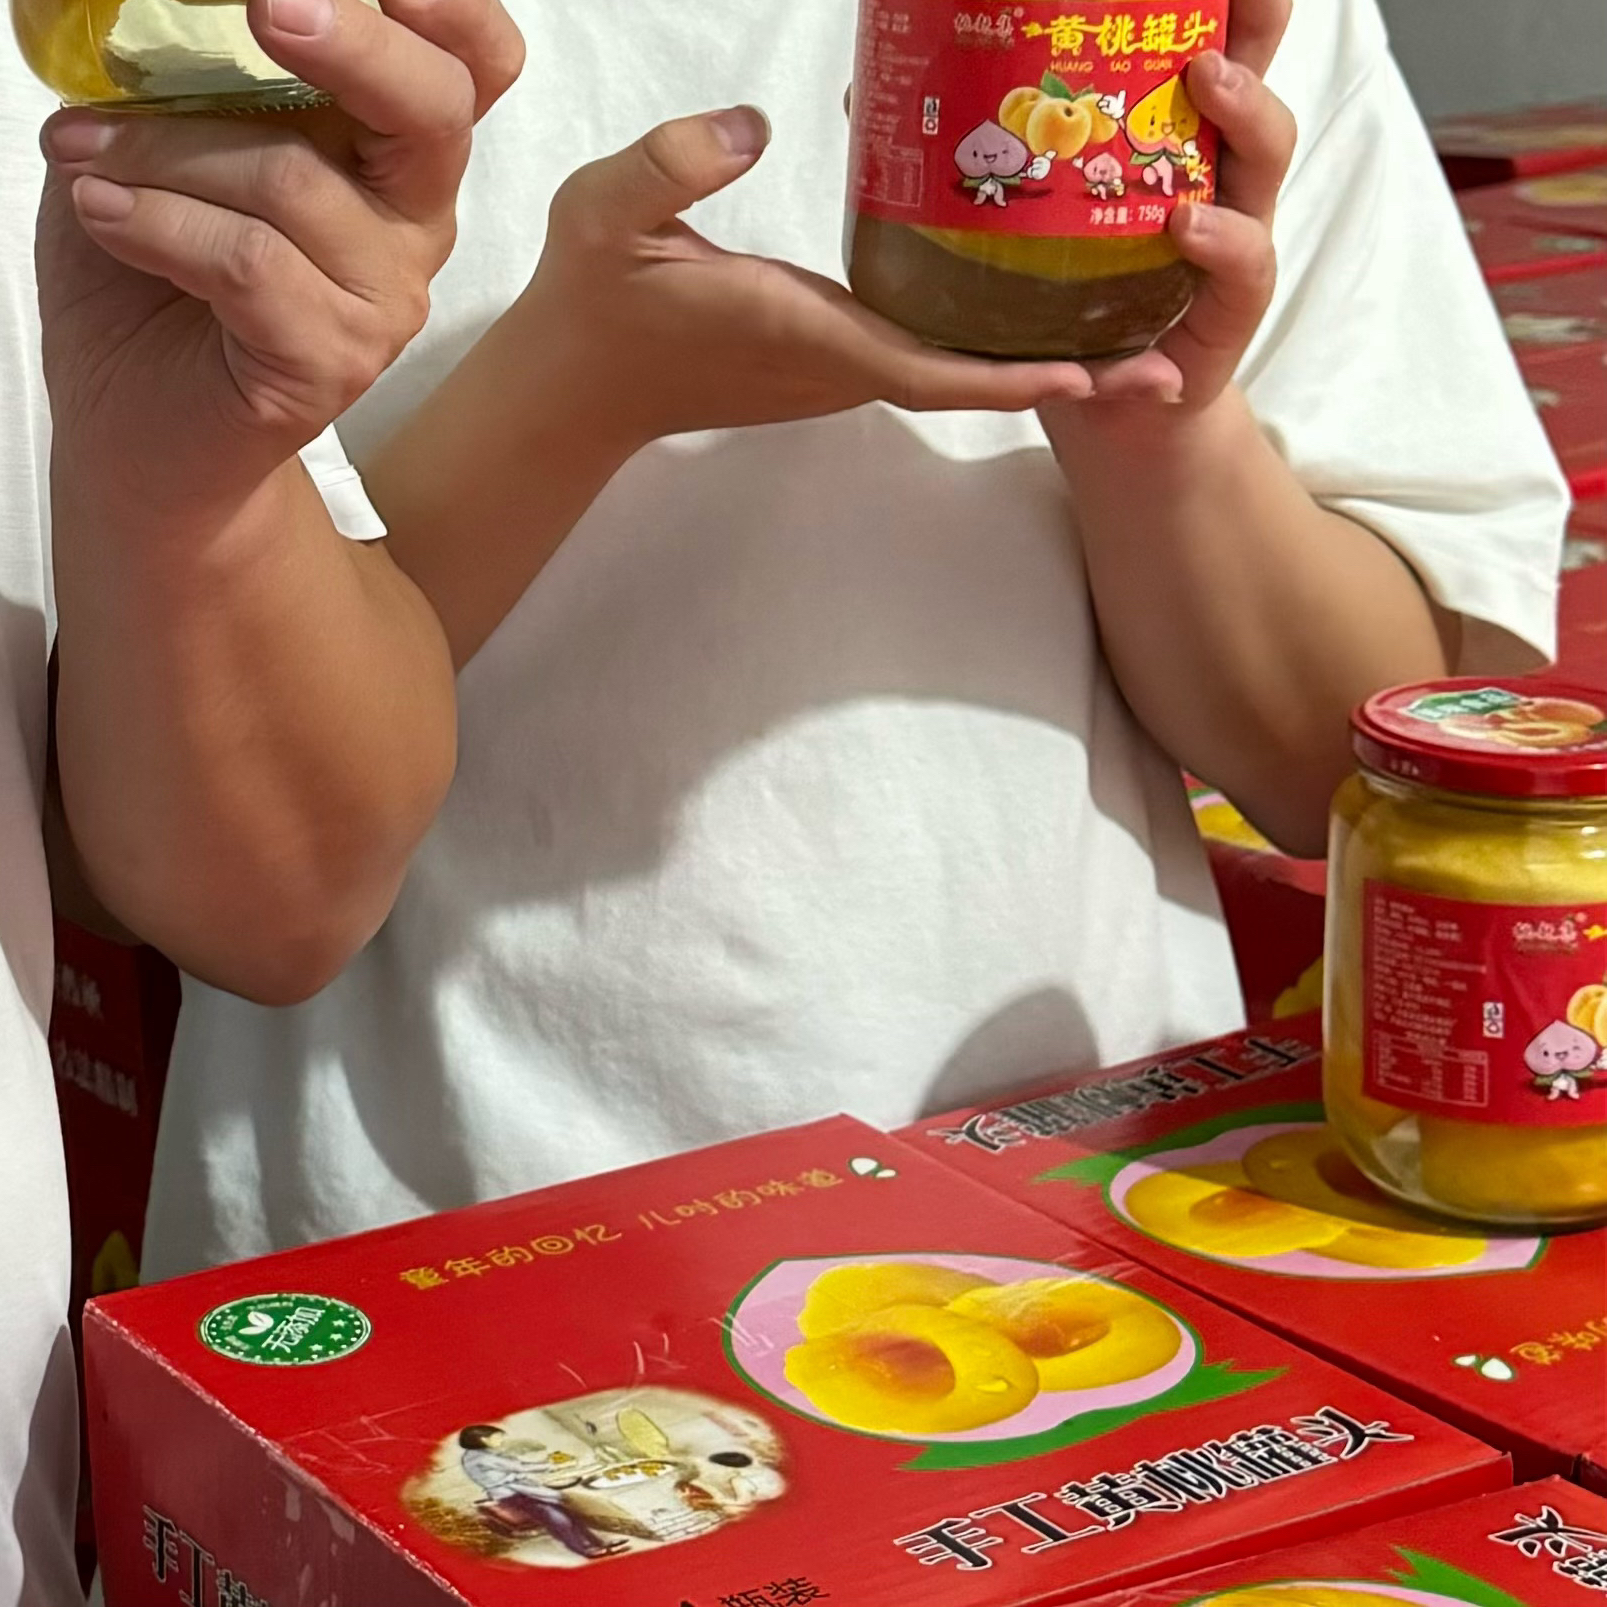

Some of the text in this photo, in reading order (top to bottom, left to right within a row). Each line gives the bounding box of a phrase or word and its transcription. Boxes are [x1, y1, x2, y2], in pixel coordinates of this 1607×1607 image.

[1046, 10, 1218, 57] 黄桃罐头
[1050, 59, 1094, 73] HUANG
[400, 1168, 844, 1290] 童年的回忆 儿时的味道
[893, 1405, 1415, 1571] 手工黄桃罐头
[142, 1504, 269, 1607] 手工
